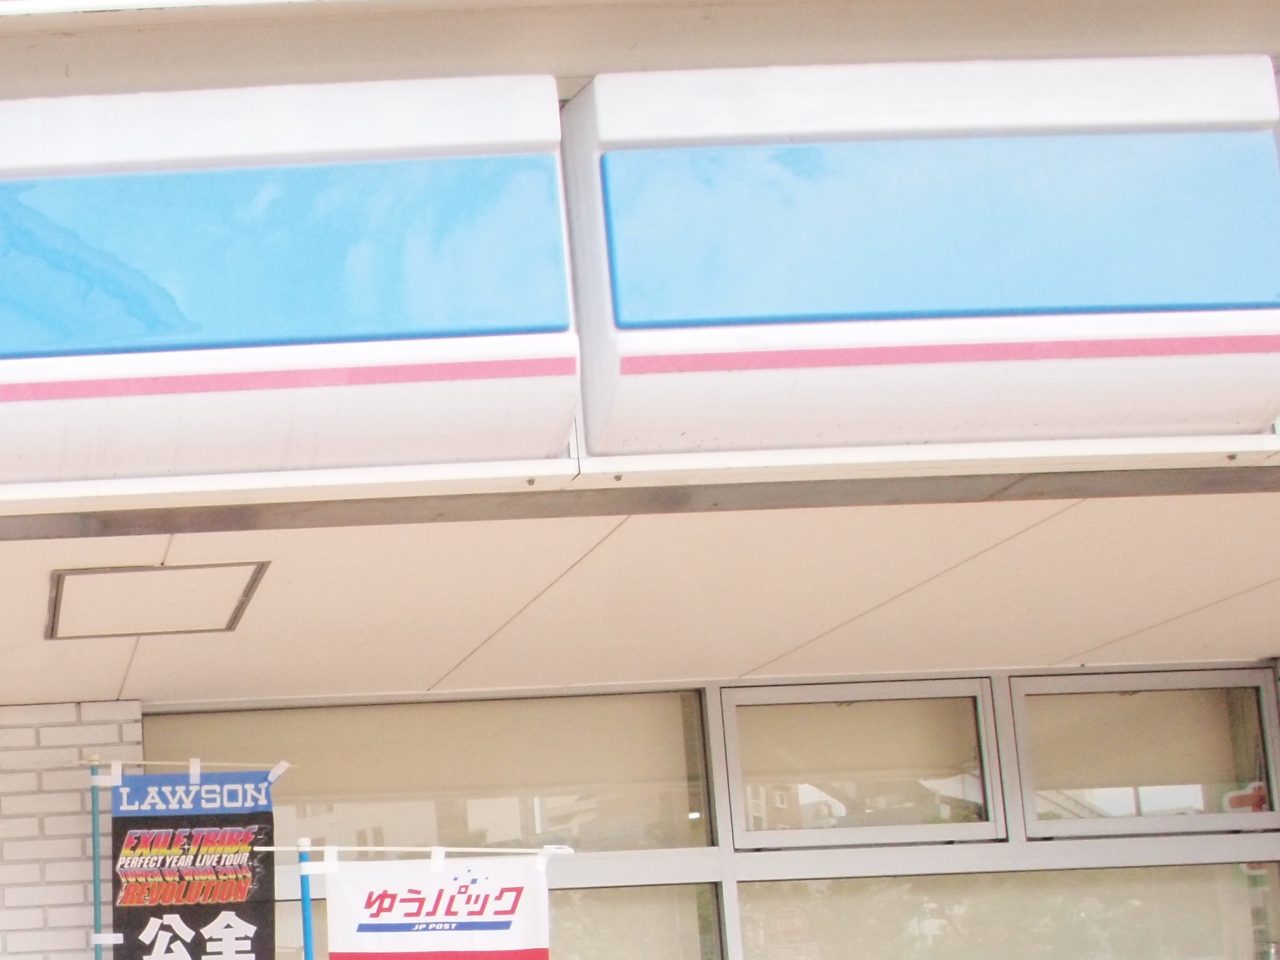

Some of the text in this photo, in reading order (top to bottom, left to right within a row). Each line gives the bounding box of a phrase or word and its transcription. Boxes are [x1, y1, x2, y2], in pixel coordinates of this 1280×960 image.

[120, 782, 268, 811] LAWSON
[119, 825, 259, 857] EXILE TRIBE
[117, 852, 250, 869] PERFECT YEAR LIVE TOUR
[117, 878, 251, 907] REVOLUTION
[363, 885, 524, 919] ゆうパック
[412, 922, 457, 931] JP POST
